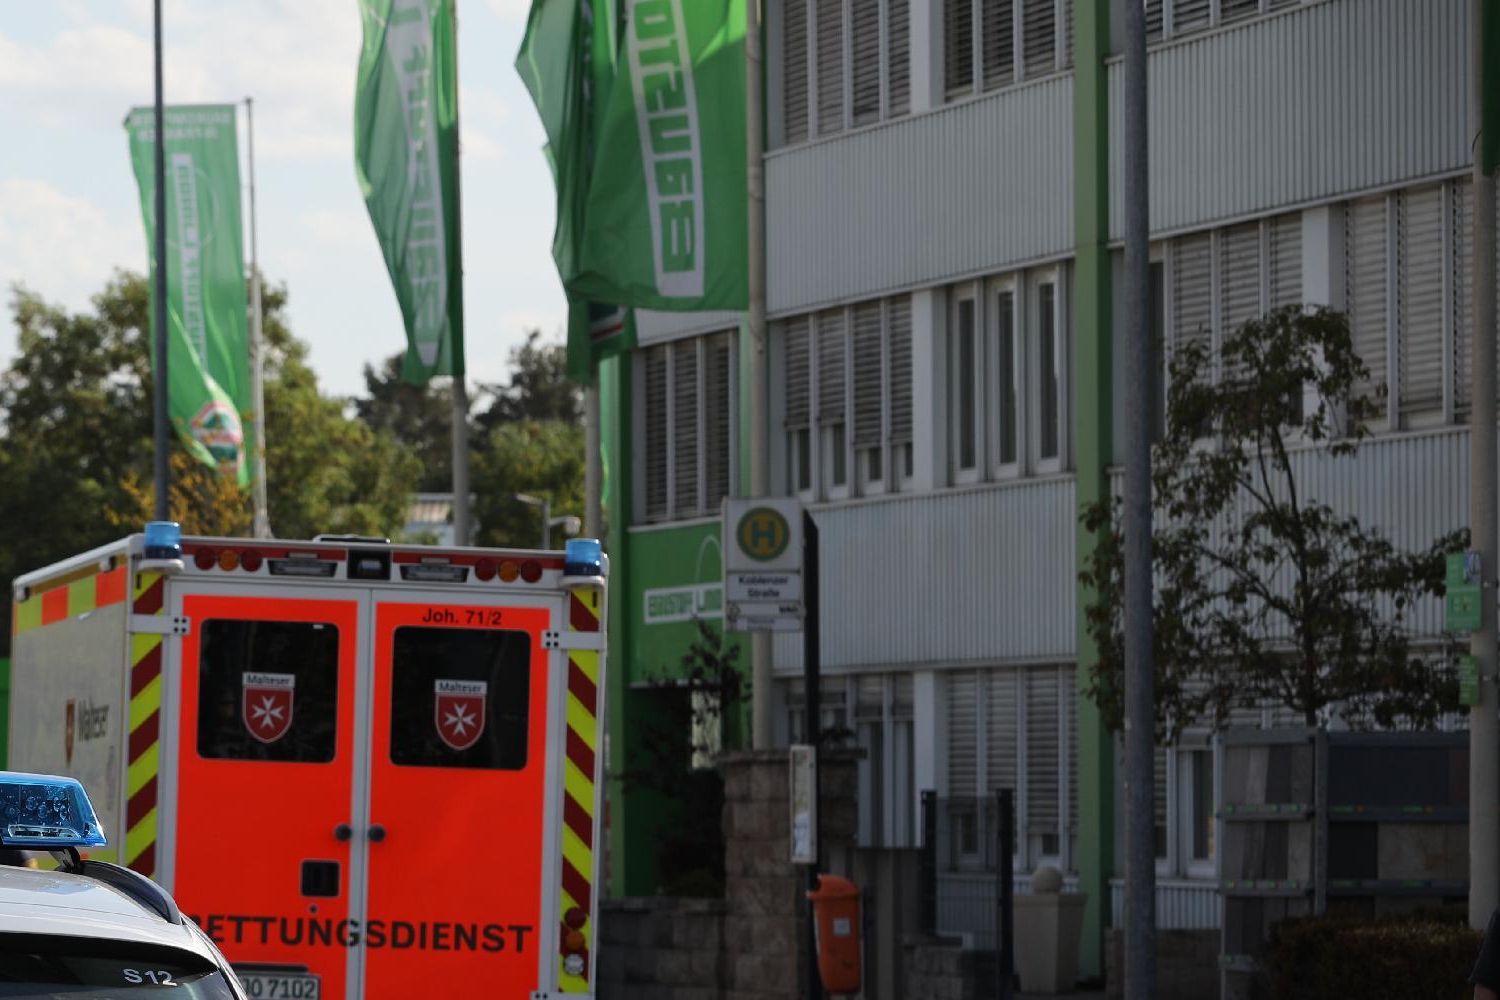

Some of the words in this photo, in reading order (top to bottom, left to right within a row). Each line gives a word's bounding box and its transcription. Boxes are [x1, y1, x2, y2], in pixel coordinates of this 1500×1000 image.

[422, 607, 459, 624] Joh.
[465, 609, 502, 626] 71/2
[246, 674, 291, 687] Malteser
[438, 681, 483, 694] Malteser
[123, 967, 178, 987] S12
[268, 979, 316, 1000] 7102
